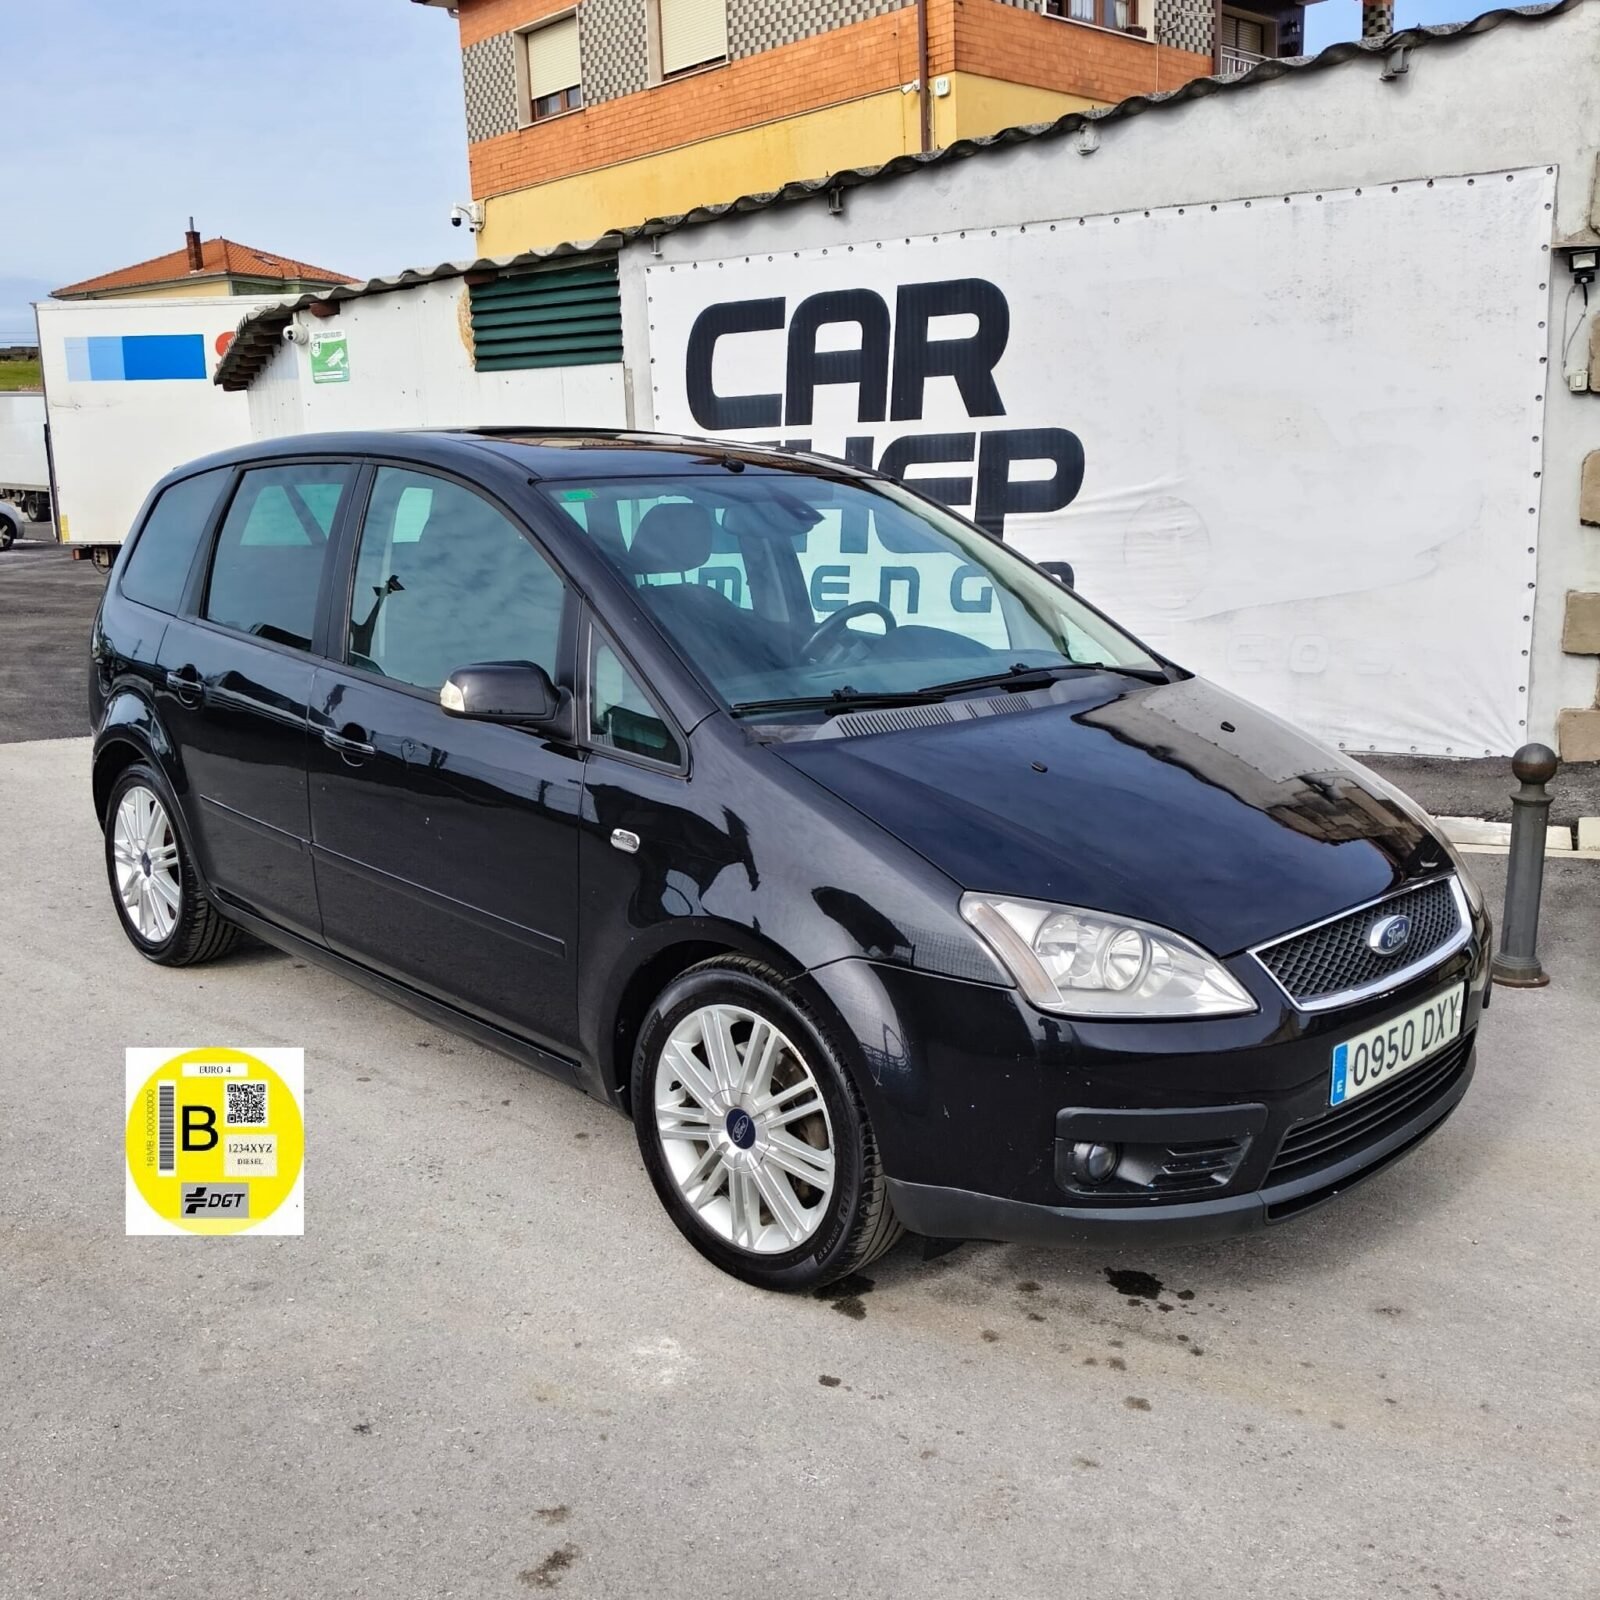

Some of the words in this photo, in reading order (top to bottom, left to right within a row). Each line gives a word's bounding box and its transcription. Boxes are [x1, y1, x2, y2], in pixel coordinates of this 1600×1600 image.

[685, 277, 1010, 430] CAR
[711, 426, 1085, 554] HEP
[698, 560, 1075, 614] MENG
[1386, 922, 1409, 948] Ford
[1353, 1019, 1415, 1087] 0950
[1421, 991, 1460, 1052] DXY
